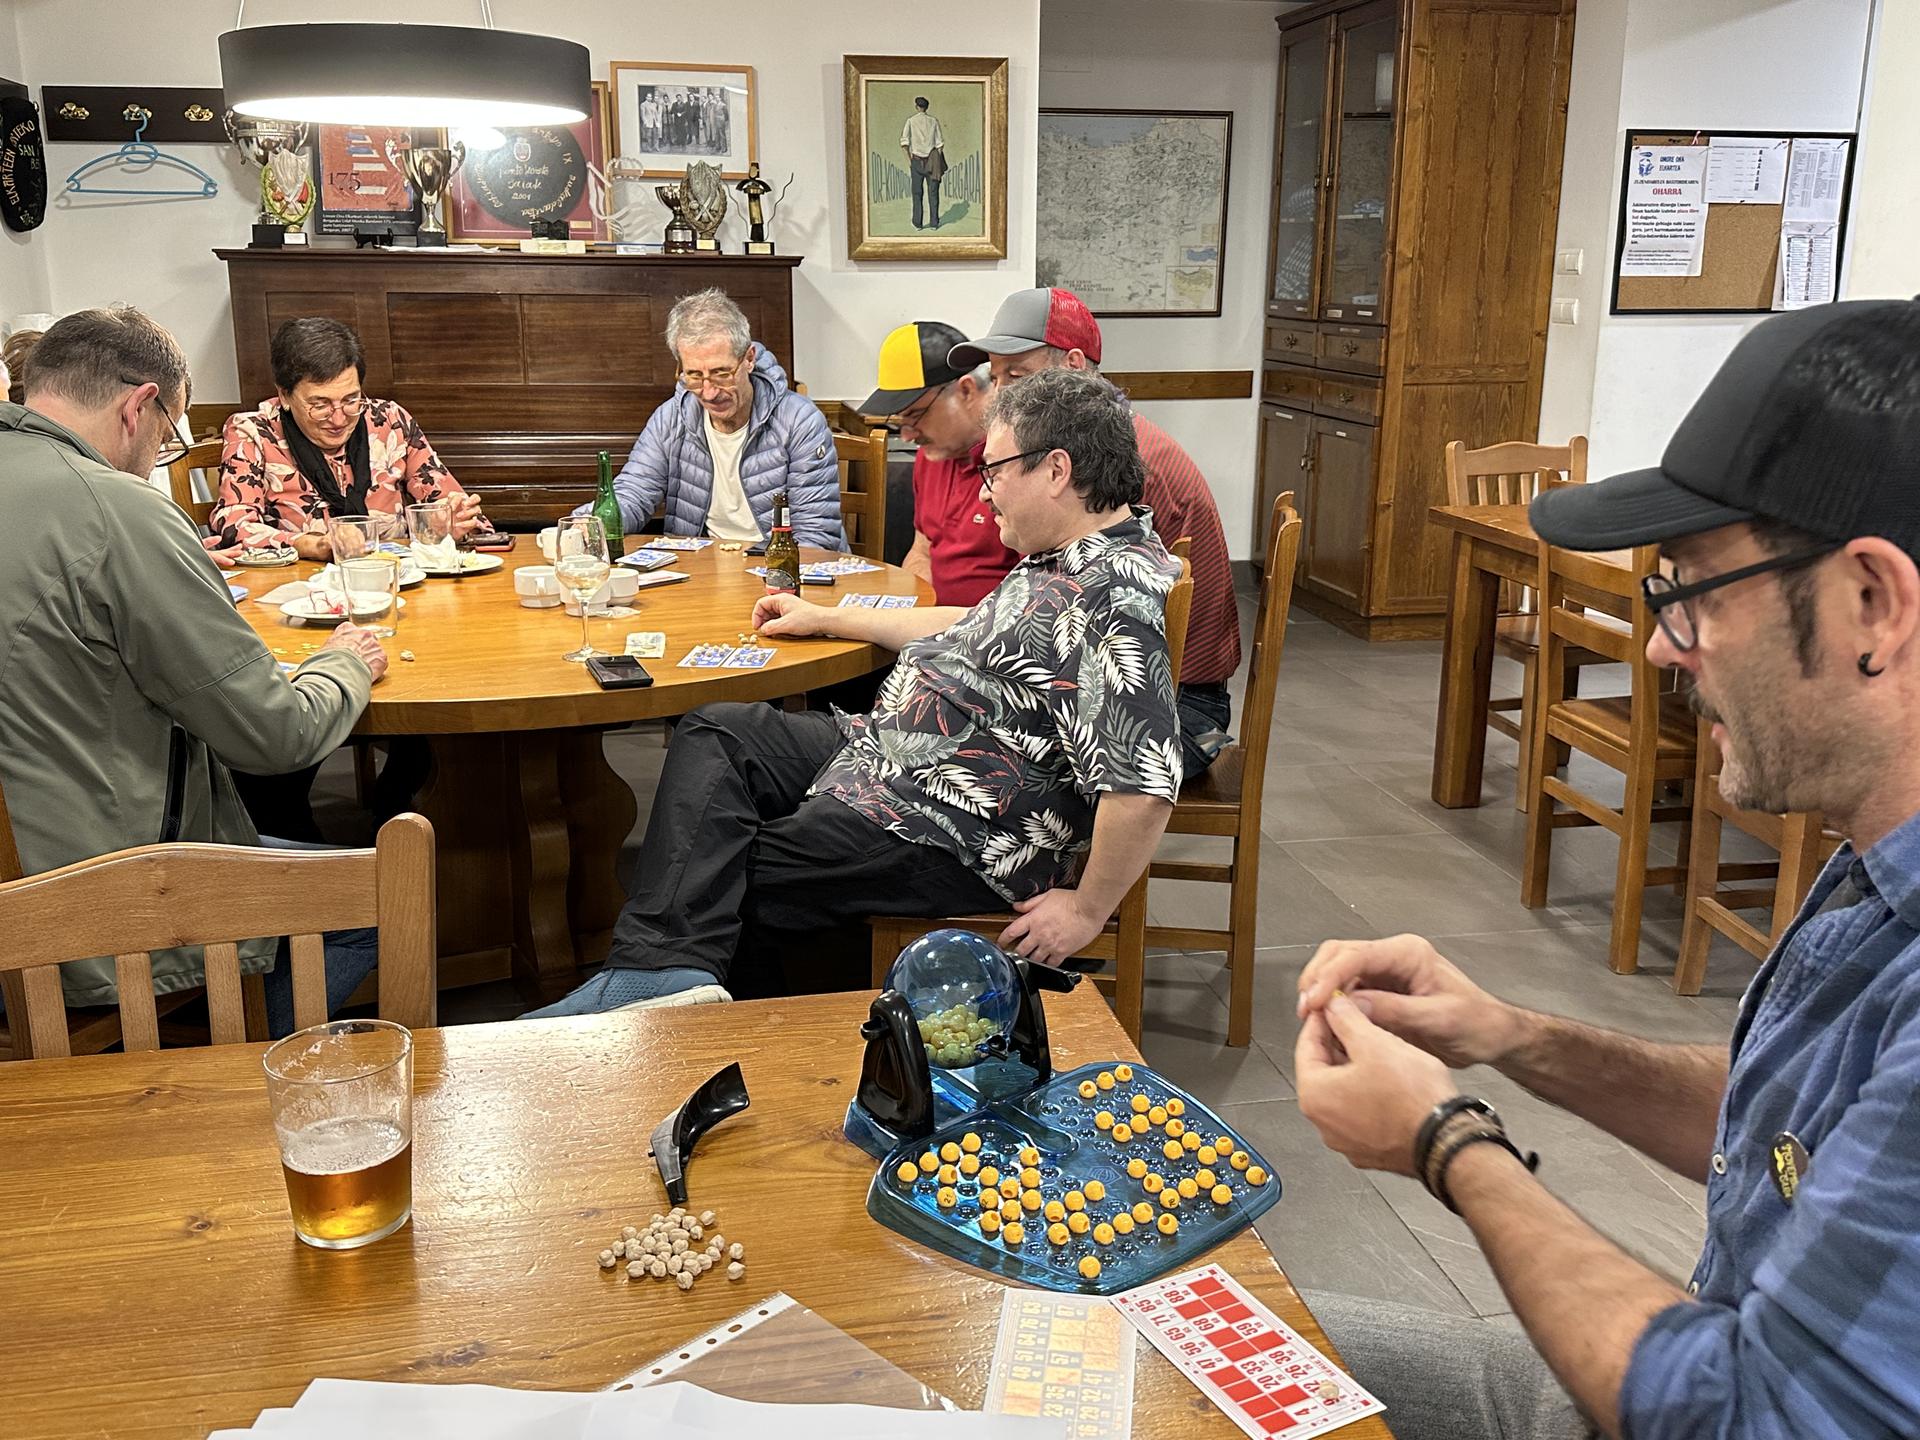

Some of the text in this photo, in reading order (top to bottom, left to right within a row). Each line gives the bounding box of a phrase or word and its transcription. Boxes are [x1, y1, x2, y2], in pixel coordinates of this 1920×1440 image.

[19, 144, 35, 156] SAN
[329, 172, 361, 191] 175
[942, 150, 981, 204] VERGARA
[1019, 1317, 1039, 1330] 76
[1236, 1322, 1258, 1336] 59
[1016, 1332, 1037, 1346] 64
[1135, 1299, 1216, 1369] 47 56 65 71 85
[1014, 1350, 1034, 1362] 51
[1050, 1353, 1070, 1365] 57
[1164, 1289, 1310, 1416] 4 20 33 68 88
[1268, 1350, 1291, 1365] 38
[1285, 1364, 1309, 1379] 26
[1082, 1373, 1103, 1385] 41
[1045, 1385, 1066, 1399] 35
[1303, 1380, 1322, 1393] 12
[1080, 1388, 1101, 1402] 32
[1043, 1403, 1064, 1418] 23
[1079, 1406, 1100, 1420] 29
